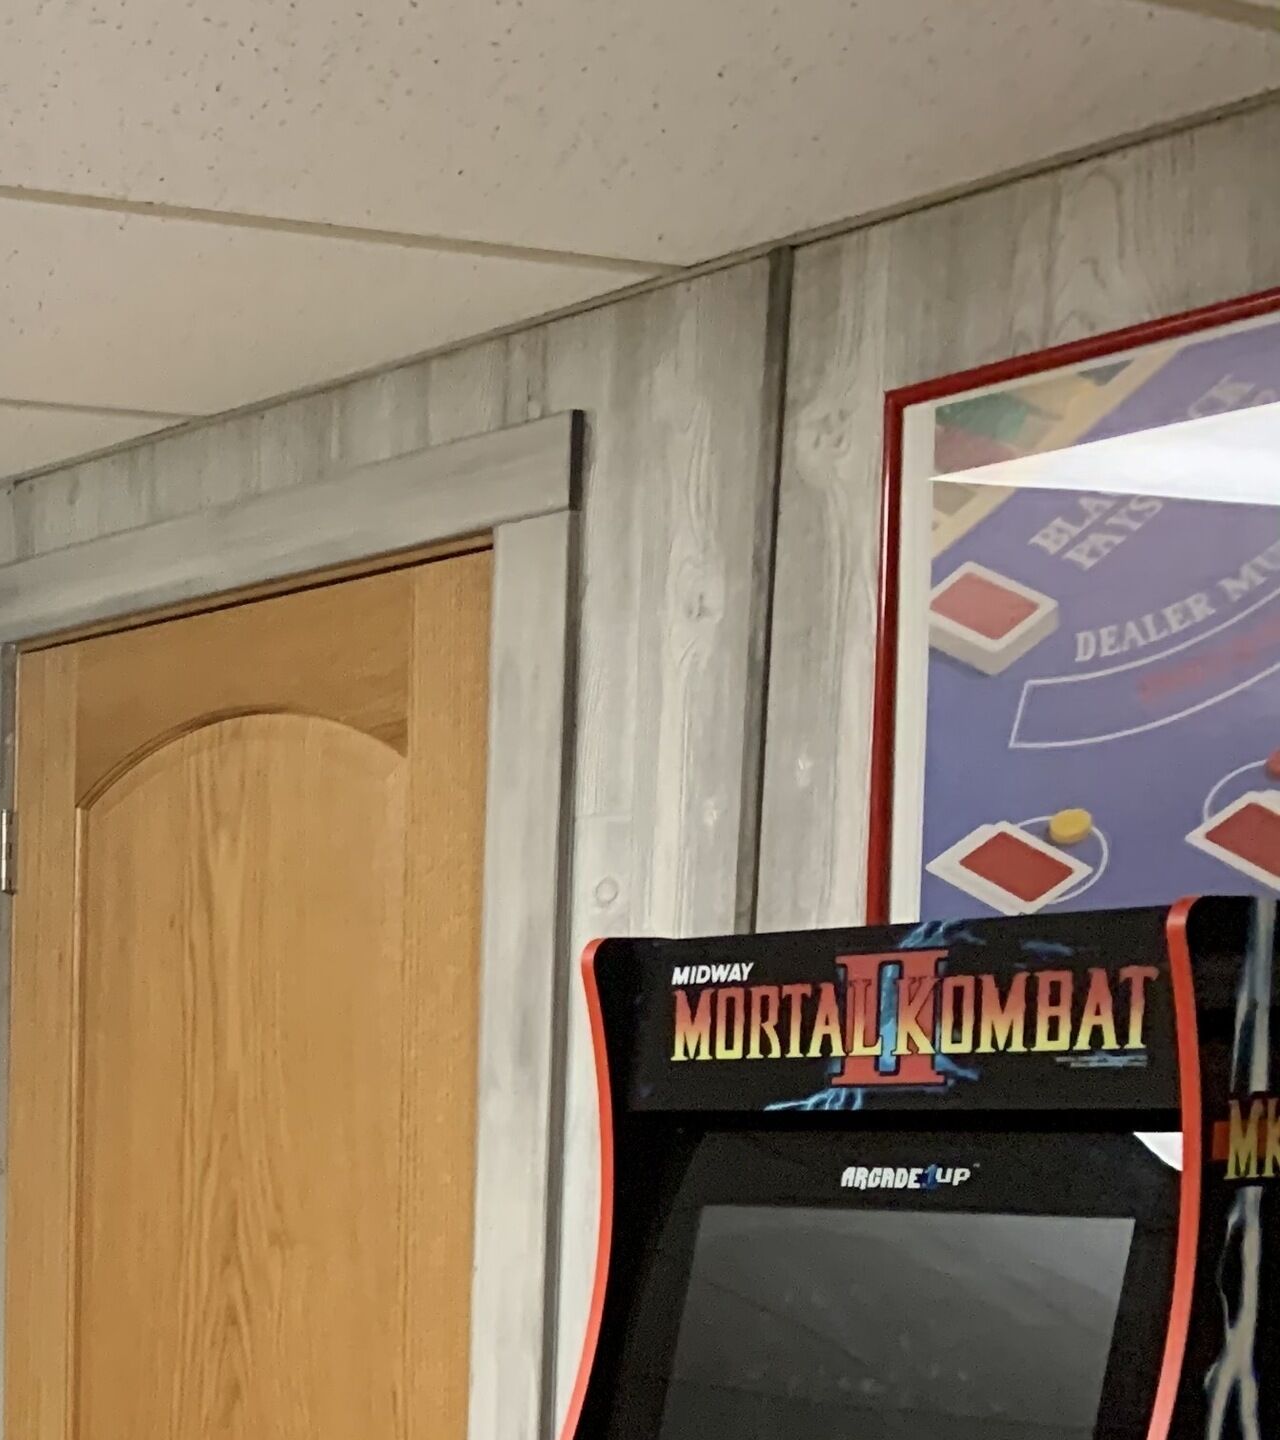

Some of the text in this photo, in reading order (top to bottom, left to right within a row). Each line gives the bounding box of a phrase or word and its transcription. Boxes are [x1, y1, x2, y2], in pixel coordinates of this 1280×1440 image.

[1062, 497, 1164, 571] PAYS
[1074, 592, 1217, 663] DEALER
[671, 962, 754, 986] MIDWAY
[669, 982, 883, 1062] MORTAL
[891, 964, 1160, 1056] KOMBAT
